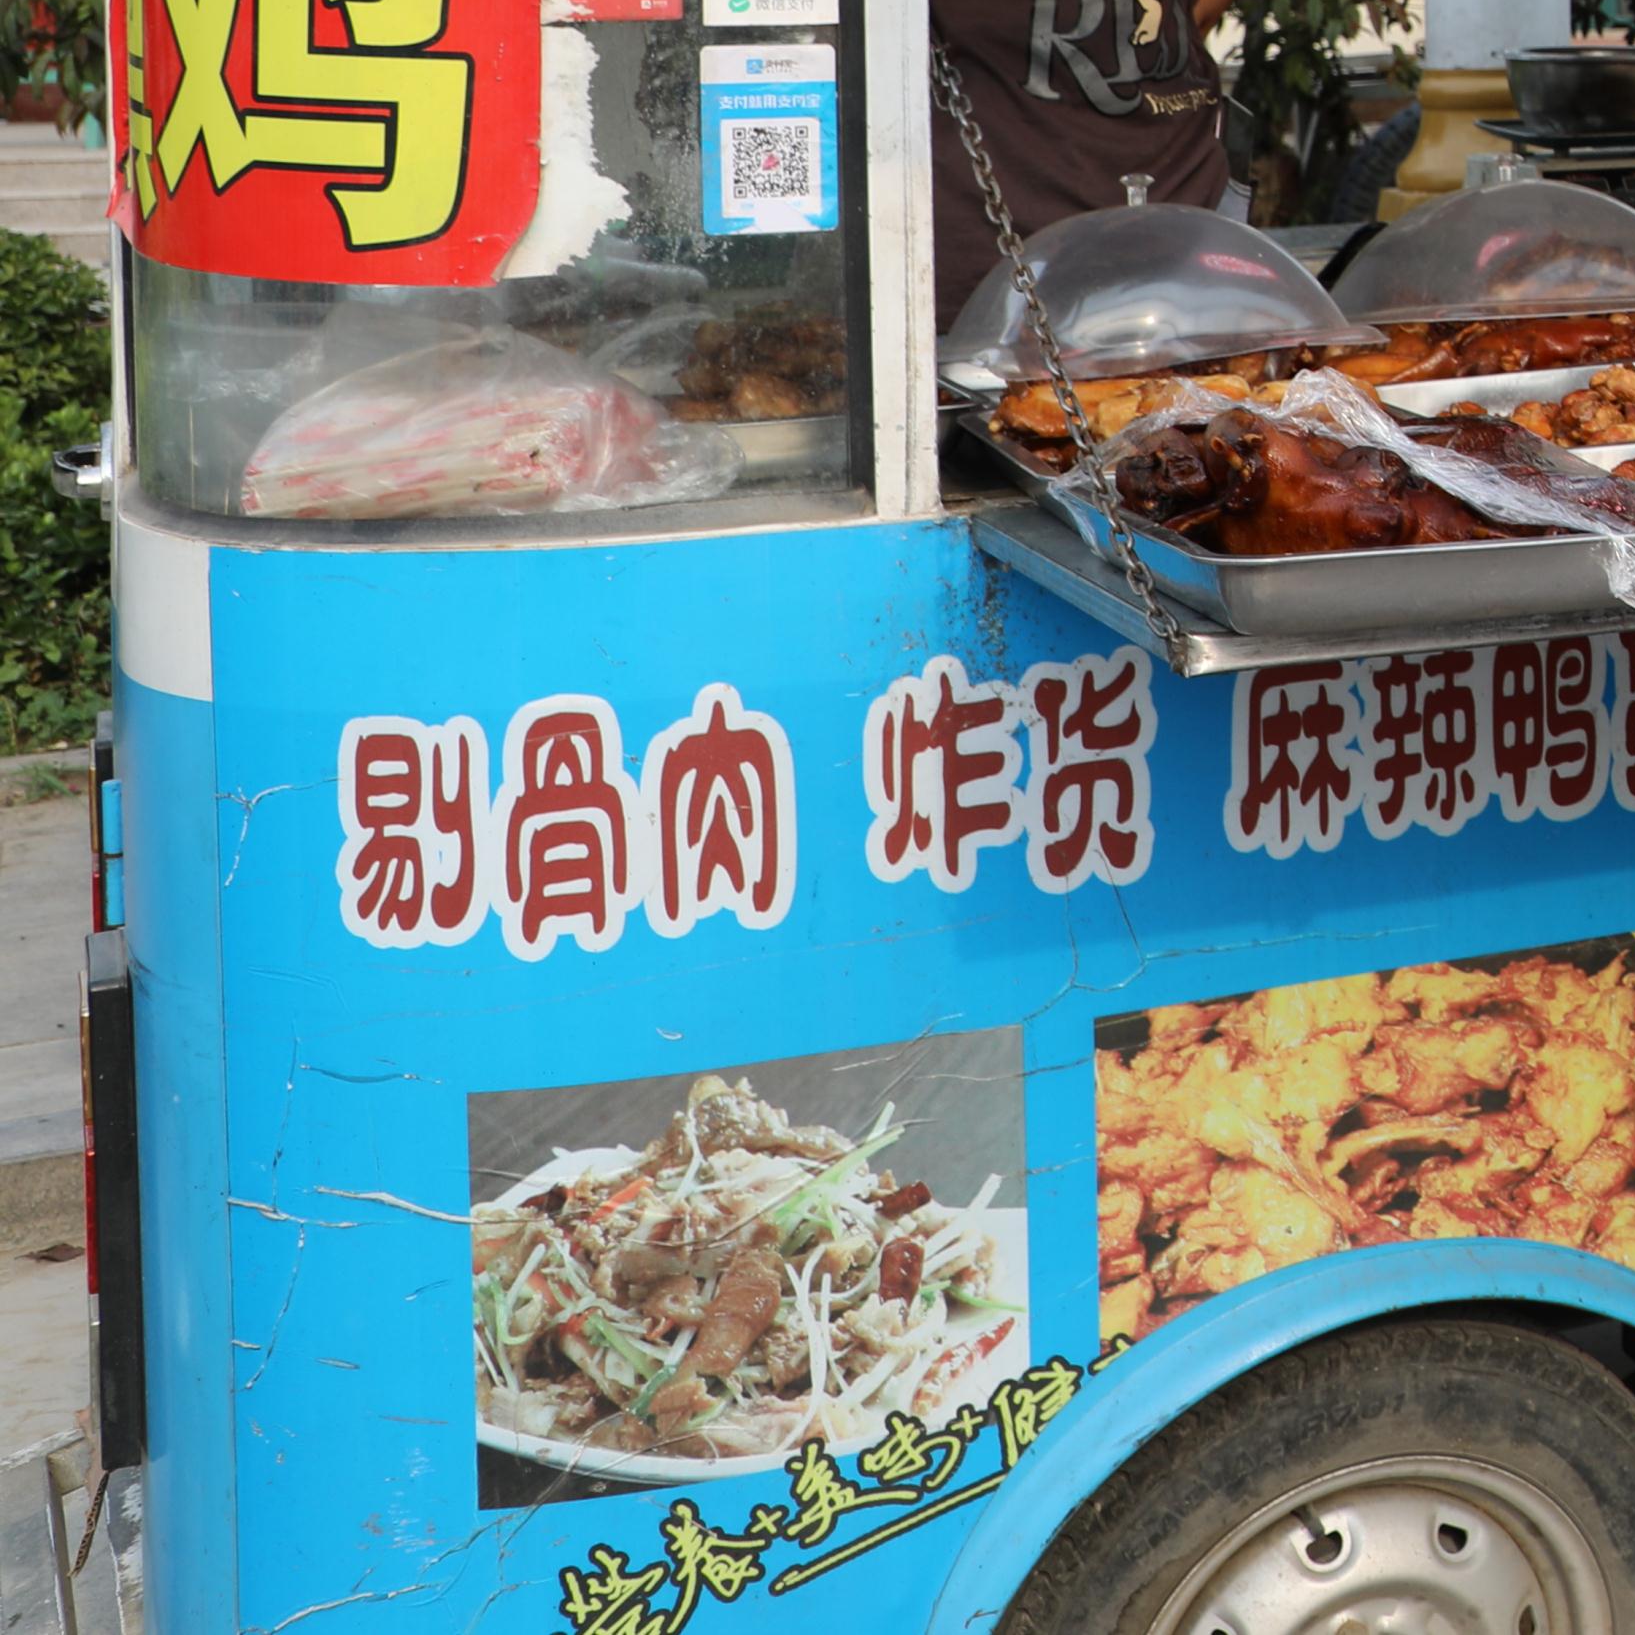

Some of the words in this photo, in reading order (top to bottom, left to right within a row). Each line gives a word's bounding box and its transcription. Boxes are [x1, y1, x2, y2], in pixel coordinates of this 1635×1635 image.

[719, 94, 821, 109] 支付就用支付宝
[336, 682, 797, 962] 剔骨肉
[862, 645, 1158, 893] 炸货
